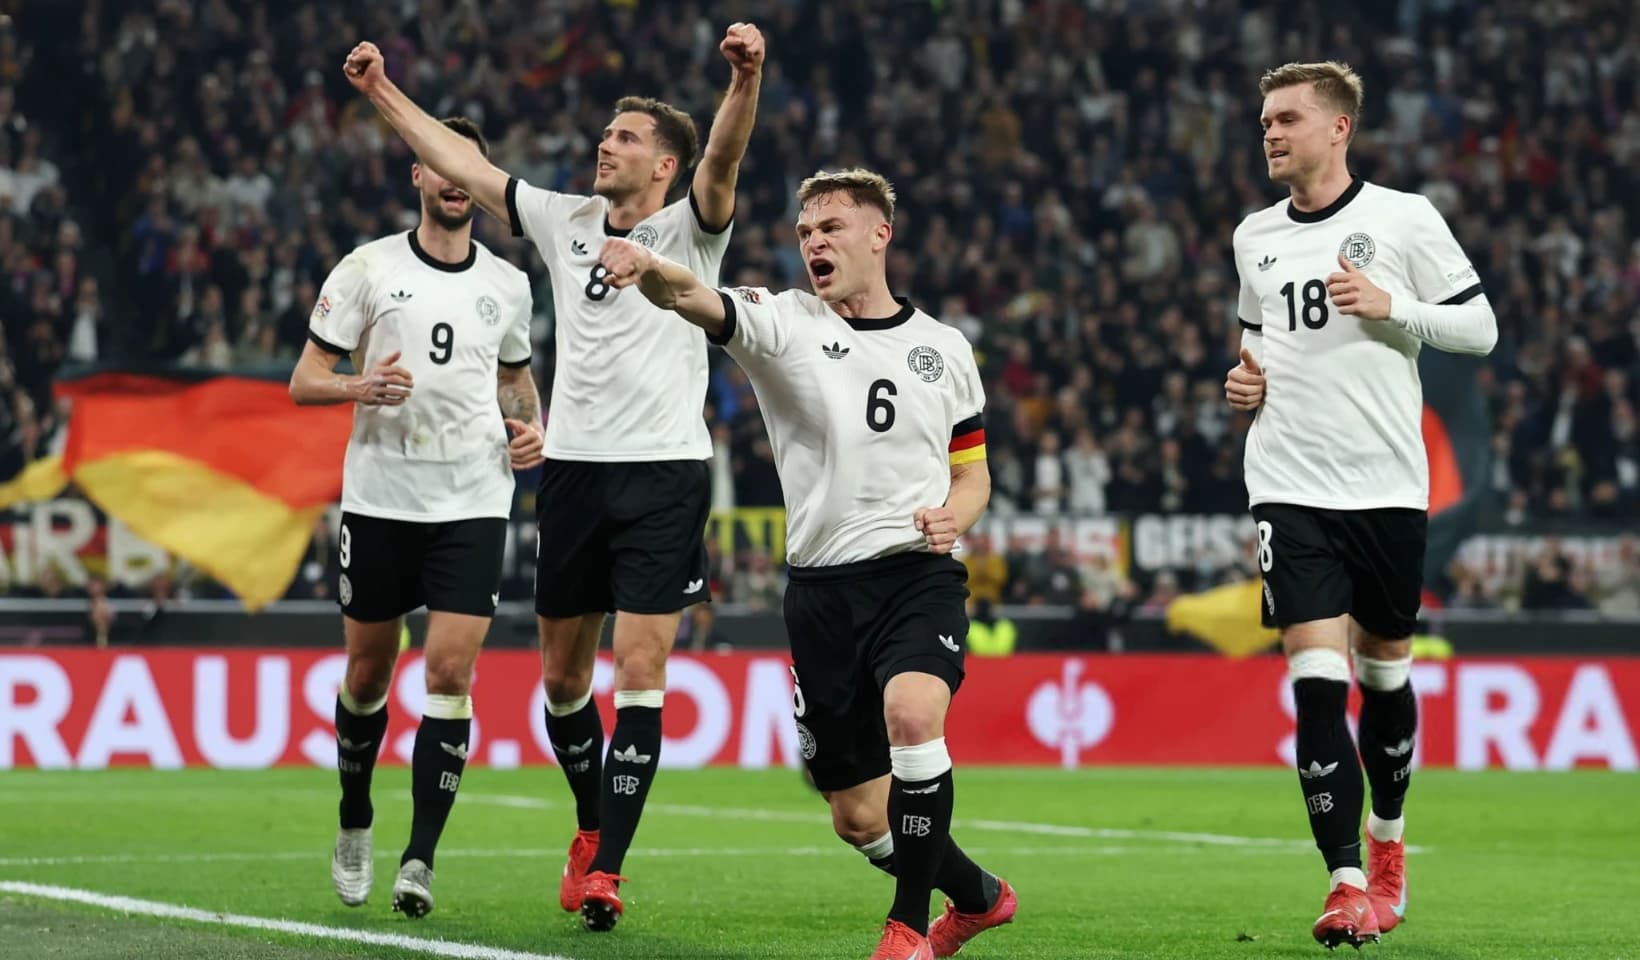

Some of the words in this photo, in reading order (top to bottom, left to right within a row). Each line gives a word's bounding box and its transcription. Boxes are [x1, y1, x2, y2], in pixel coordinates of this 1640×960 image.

[585, 263, 612, 301] 8
[1279, 278, 1329, 332] 18
[429, 322, 454, 365] 9
[866, 378, 898, 433] 6
[340, 523, 351, 569] 9
